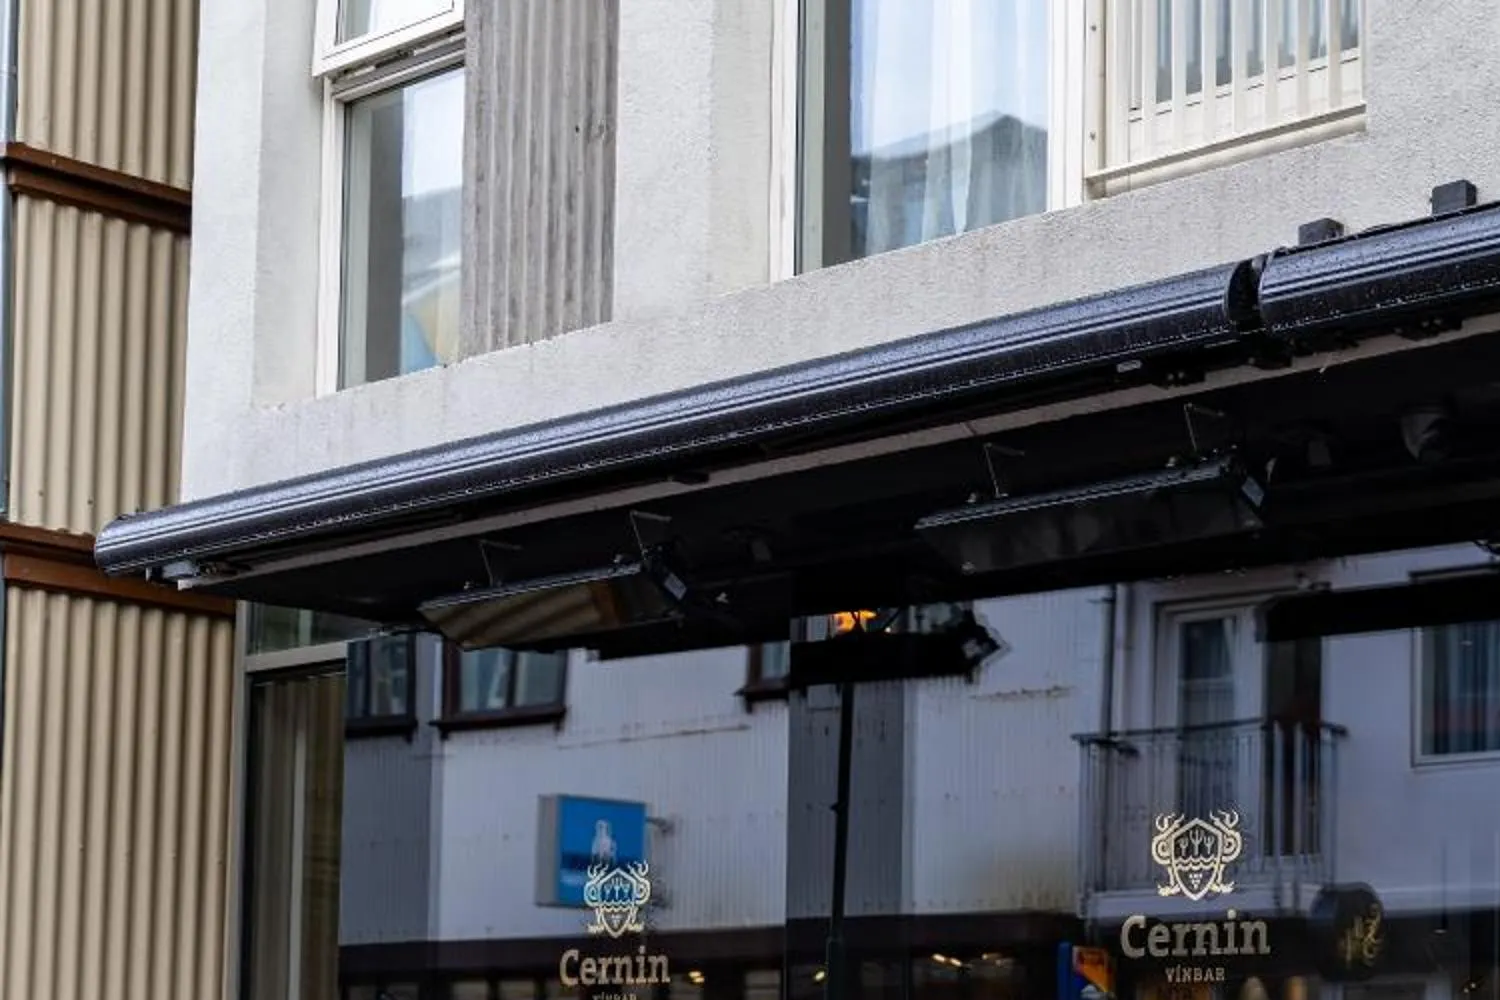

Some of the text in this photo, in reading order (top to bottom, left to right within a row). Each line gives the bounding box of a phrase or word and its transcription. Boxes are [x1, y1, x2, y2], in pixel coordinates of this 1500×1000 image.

[1120, 909, 1271, 958] Cernin
[560, 945, 671, 986] Cernin
[1165, 964, 1225, 983] VÍNBAR
